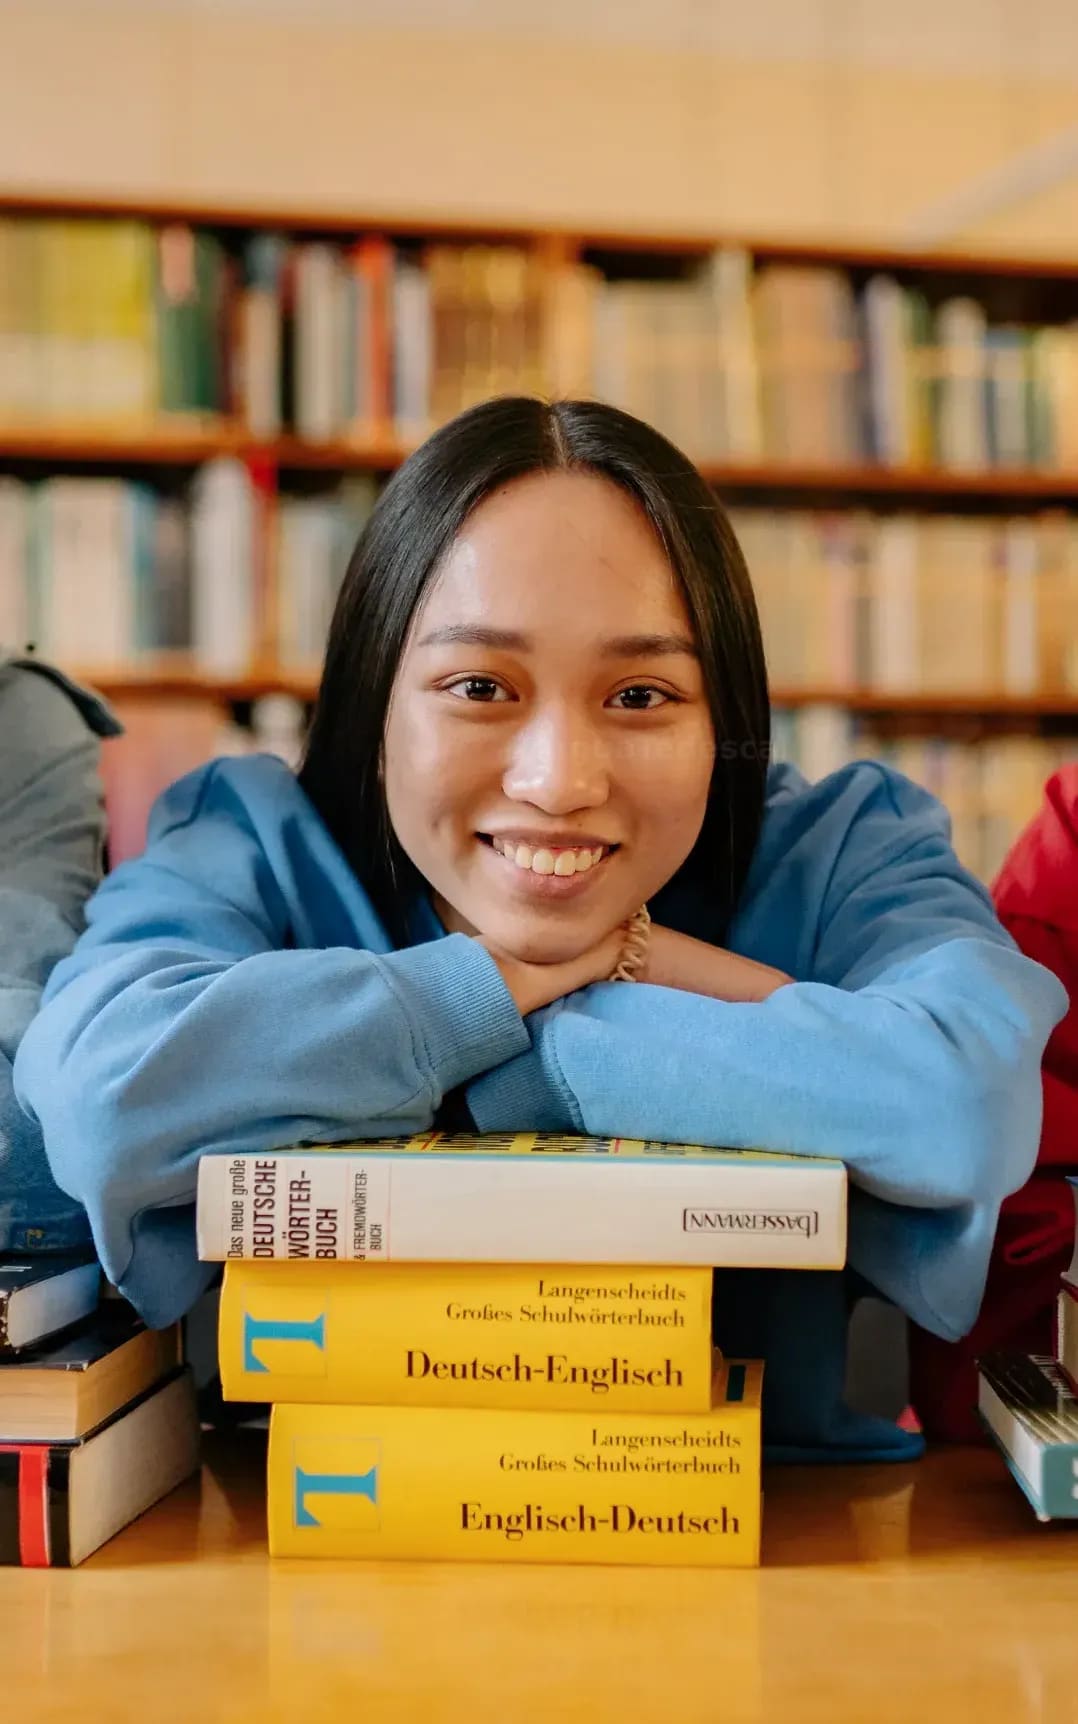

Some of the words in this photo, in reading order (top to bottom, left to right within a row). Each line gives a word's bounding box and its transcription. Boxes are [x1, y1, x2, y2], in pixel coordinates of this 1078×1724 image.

[229, 1159, 248, 1196] große
[231, 1200, 245, 1232] neue
[252, 1159, 277, 1259] DEUTSCHE
[282, 1169, 311, 1259] WÖRTER-
[352, 1168, 368, 1251] FREMDWÖRTER-
[227, 1236, 244, 1259] Das
[315, 1207, 338, 1260] BUCH
[370, 1223, 382, 1251] BUCH
[353, 1253, 366, 1261] &
[537, 1280, 687, 1304] Langenscheidts
[446, 1302, 513, 1322] Großes
[519, 1304, 686, 1328] Schulwörterbuch
[405, 1349, 685, 1394] Deutsch-Englisch
[591, 1428, 742, 1452] Langenscheidts
[499, 1453, 567, 1473] Großes
[573, 1455, 741, 1475] Schulwörterbuch
[459, 1501, 741, 1542] Englisch-Deutsch
